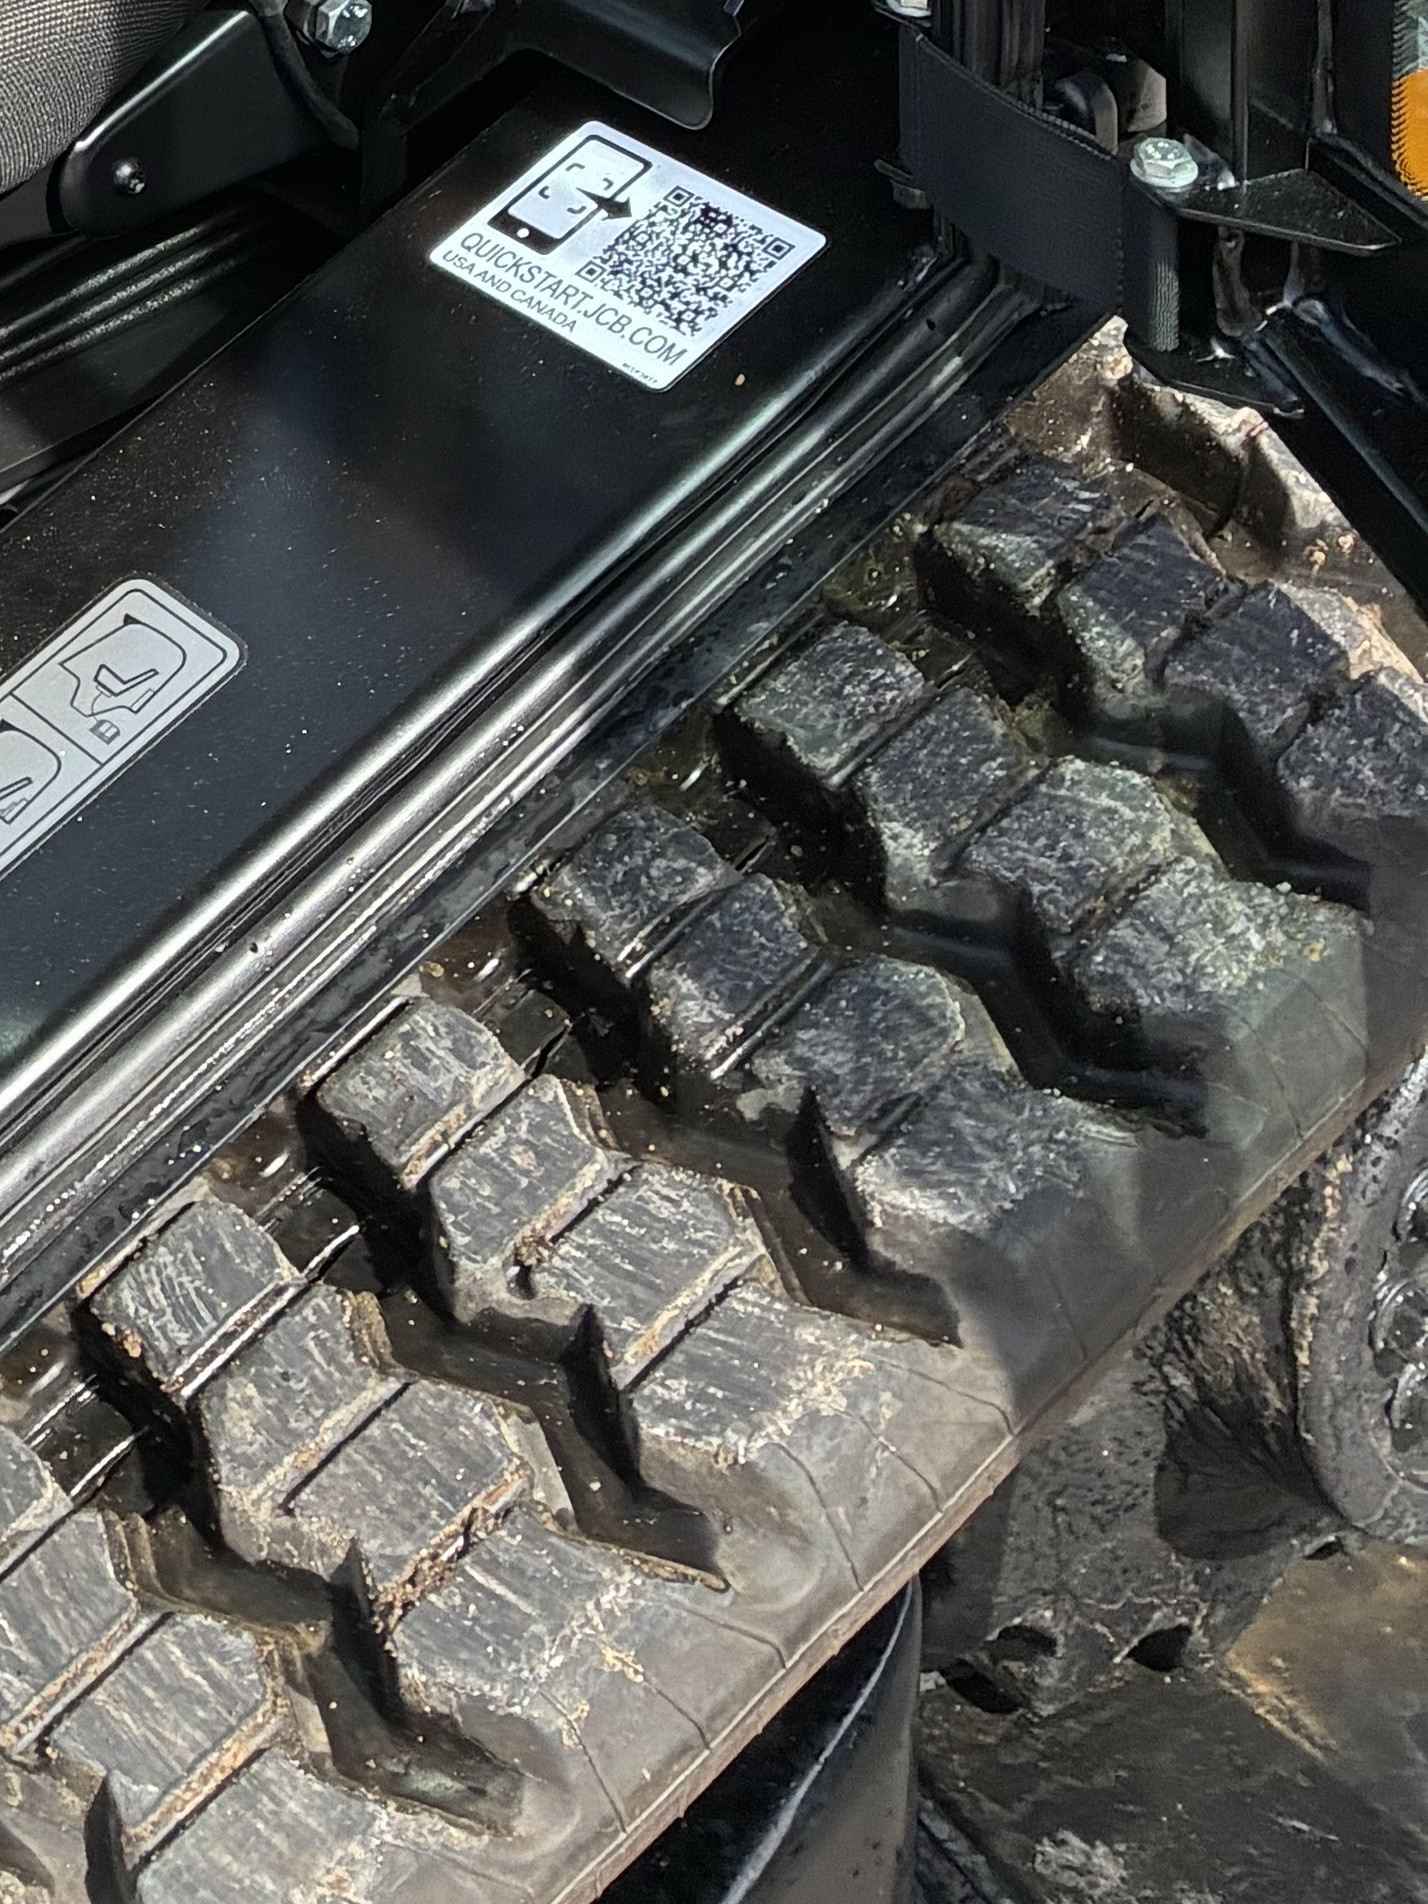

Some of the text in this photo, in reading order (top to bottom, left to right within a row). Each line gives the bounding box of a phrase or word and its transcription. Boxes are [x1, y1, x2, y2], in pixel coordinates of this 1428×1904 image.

[442, 249, 578, 333] USA AND CANADA
[460, 232, 688, 366] QUICKSTART.JCB.COM
